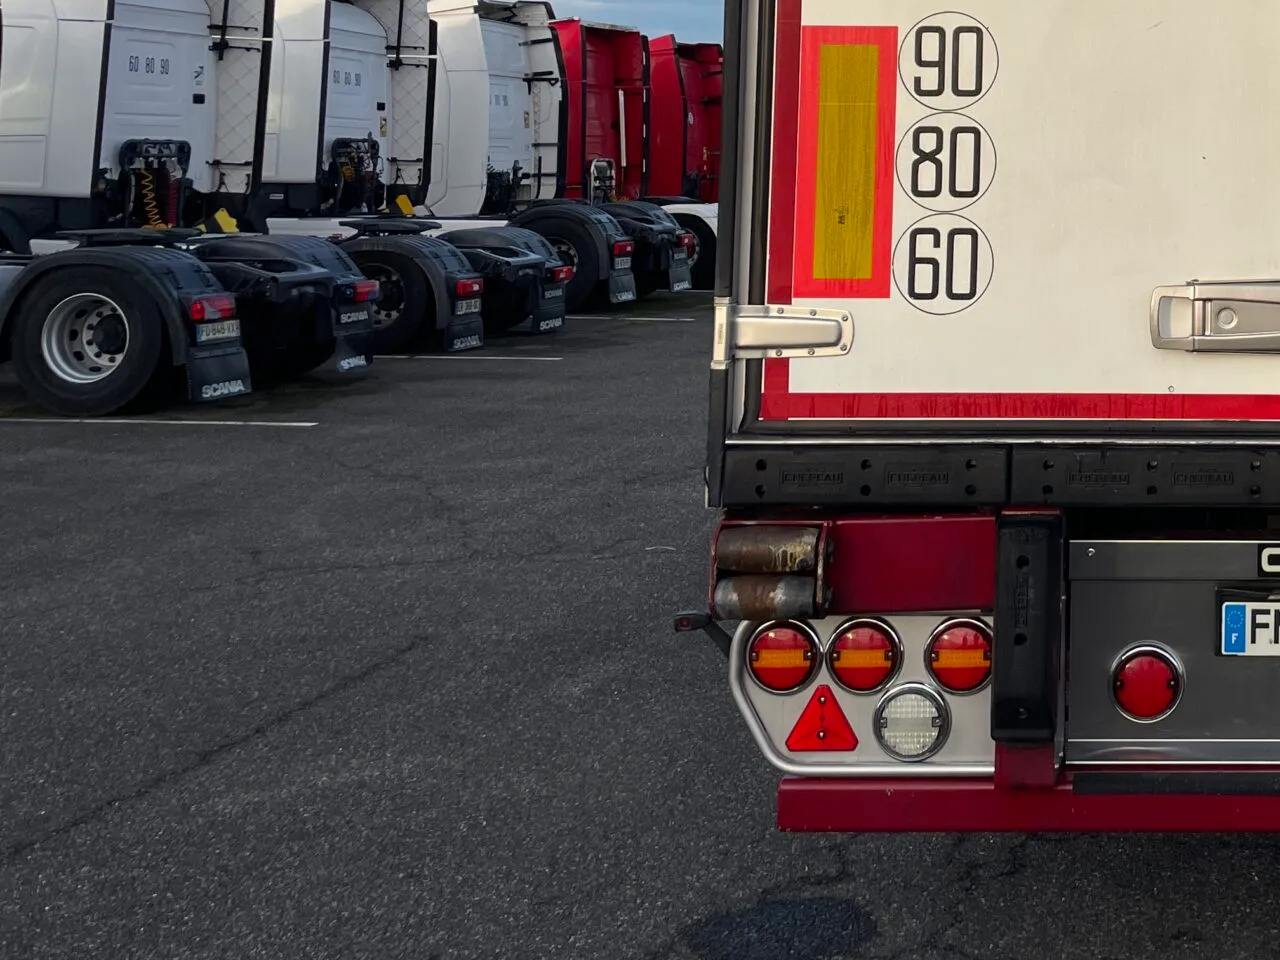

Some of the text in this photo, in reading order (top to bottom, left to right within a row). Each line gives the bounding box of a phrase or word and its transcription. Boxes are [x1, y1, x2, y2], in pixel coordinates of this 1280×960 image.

[128, 55, 170, 75] 60 80 90
[914, 25, 984, 97] 90
[911, 125, 981, 199] 80
[907, 227, 979, 301] 60
[201, 379, 245, 398] SCANIA
[1231, 633, 1239, 645] F
